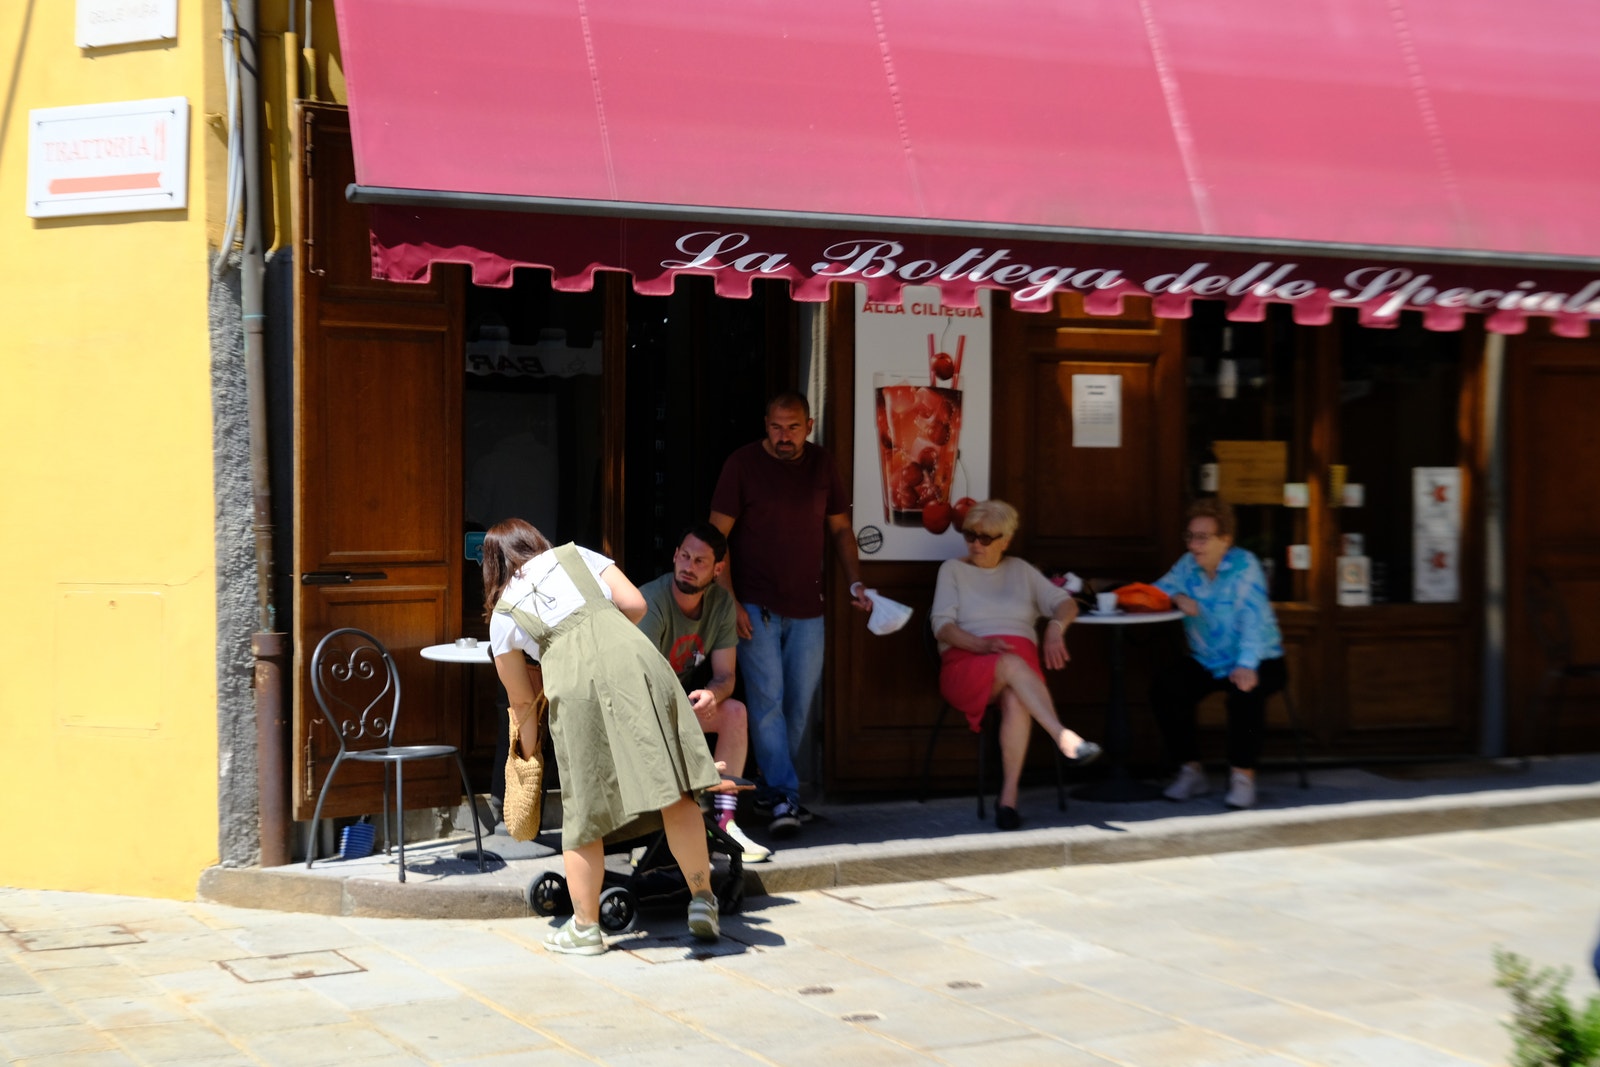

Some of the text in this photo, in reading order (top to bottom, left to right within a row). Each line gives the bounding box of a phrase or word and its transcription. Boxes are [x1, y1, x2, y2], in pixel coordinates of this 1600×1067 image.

[43, 135, 152, 162] TRATTORIA
[660, 231, 791, 273] La
[811, 239, 1125, 302] Bottega
[1143, 261, 1317, 300] delle
[862, 301, 984, 318] ALLA CILIEGIA
